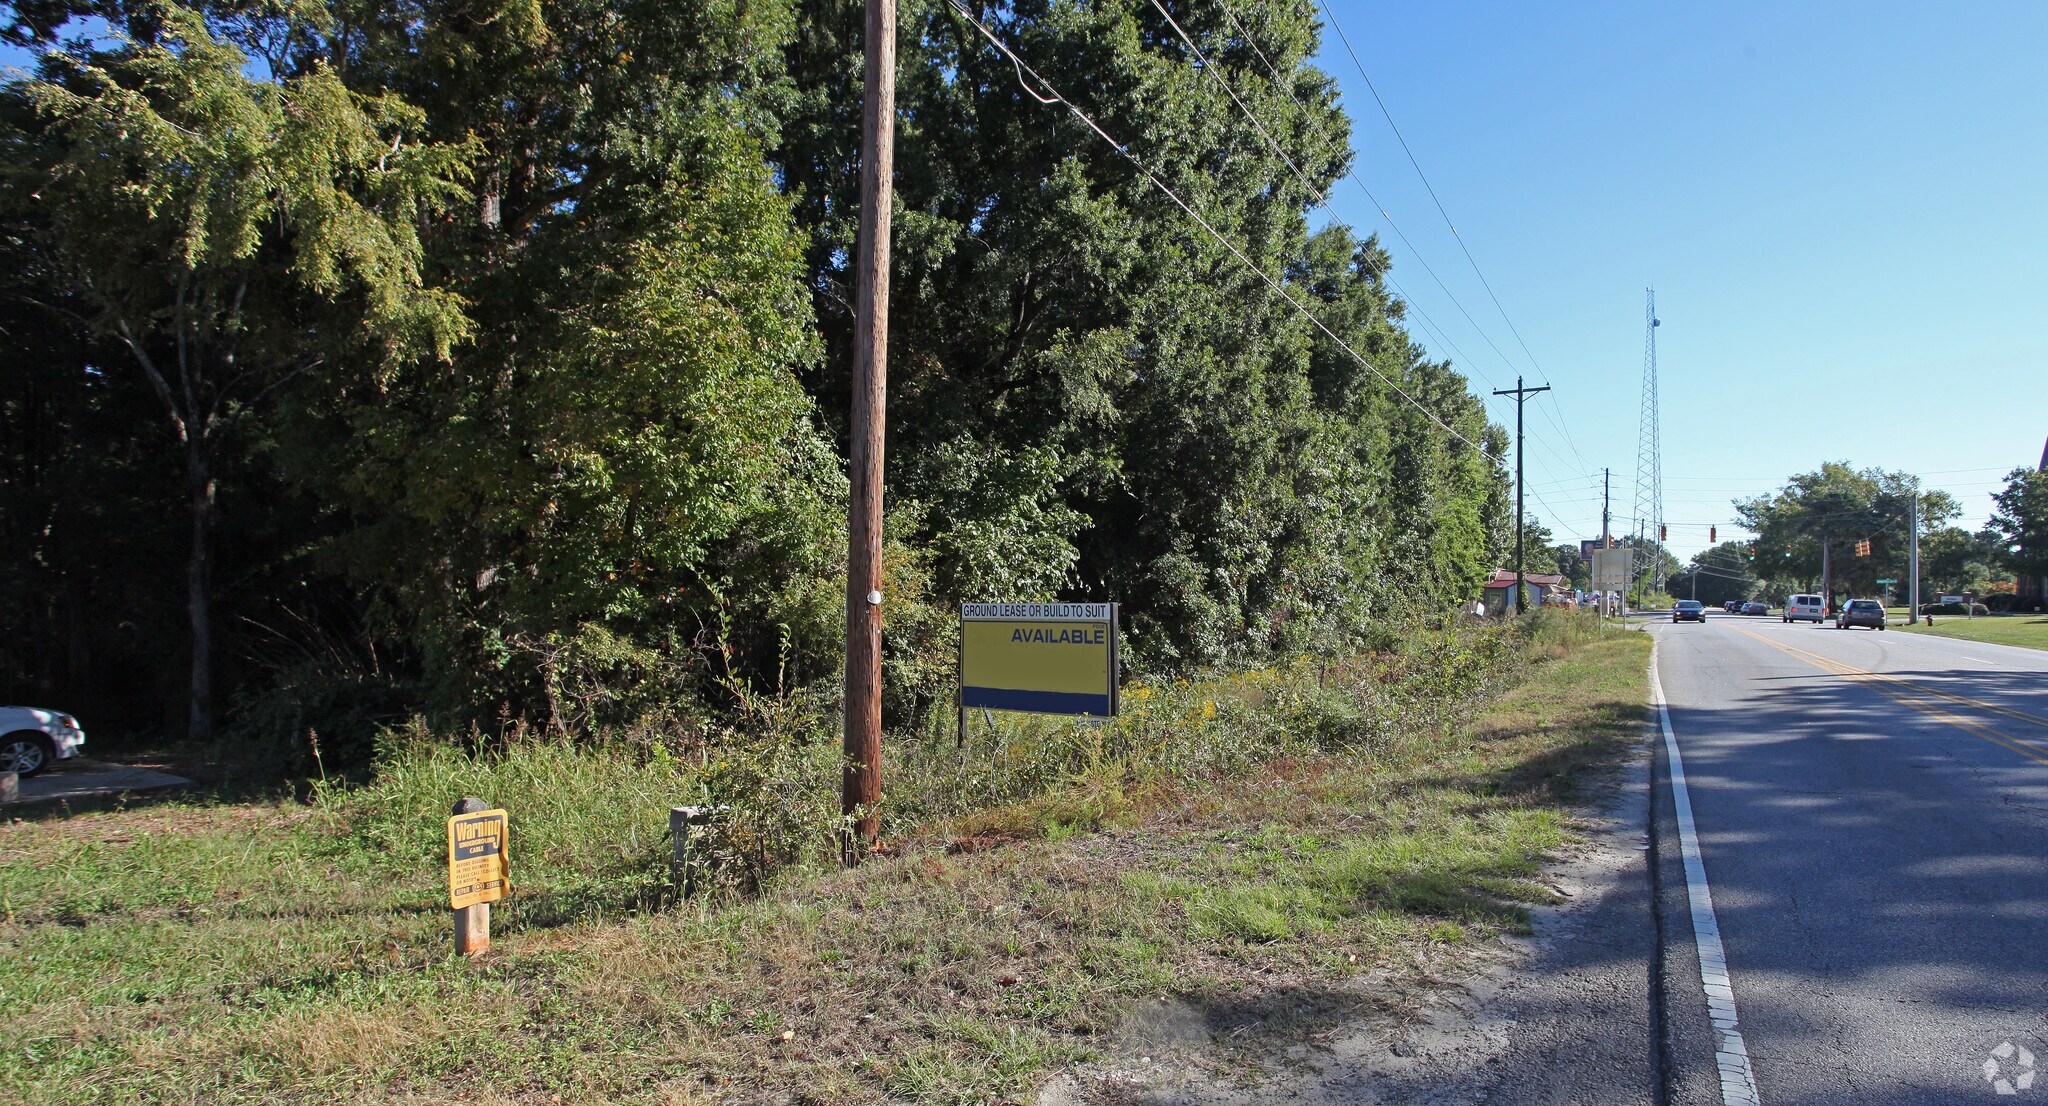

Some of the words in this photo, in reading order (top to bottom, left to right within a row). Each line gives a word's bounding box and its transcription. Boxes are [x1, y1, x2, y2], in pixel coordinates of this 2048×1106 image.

[963, 604, 998, 617] GROUND
[1000, 604, 1026, 617] LEASE
[1028, 604, 1042, 617] OR
[1044, 604, 1070, 618] BUILD
[1070, 605, 1083, 618] TO
[1085, 604, 1106, 619] SUIT
[1011, 628, 1105, 645] AVAILABLE
[455, 818, 501, 849] Warning
[458, 837, 496, 849] UNDERGROUND
[469, 845, 484, 854] CABLE
